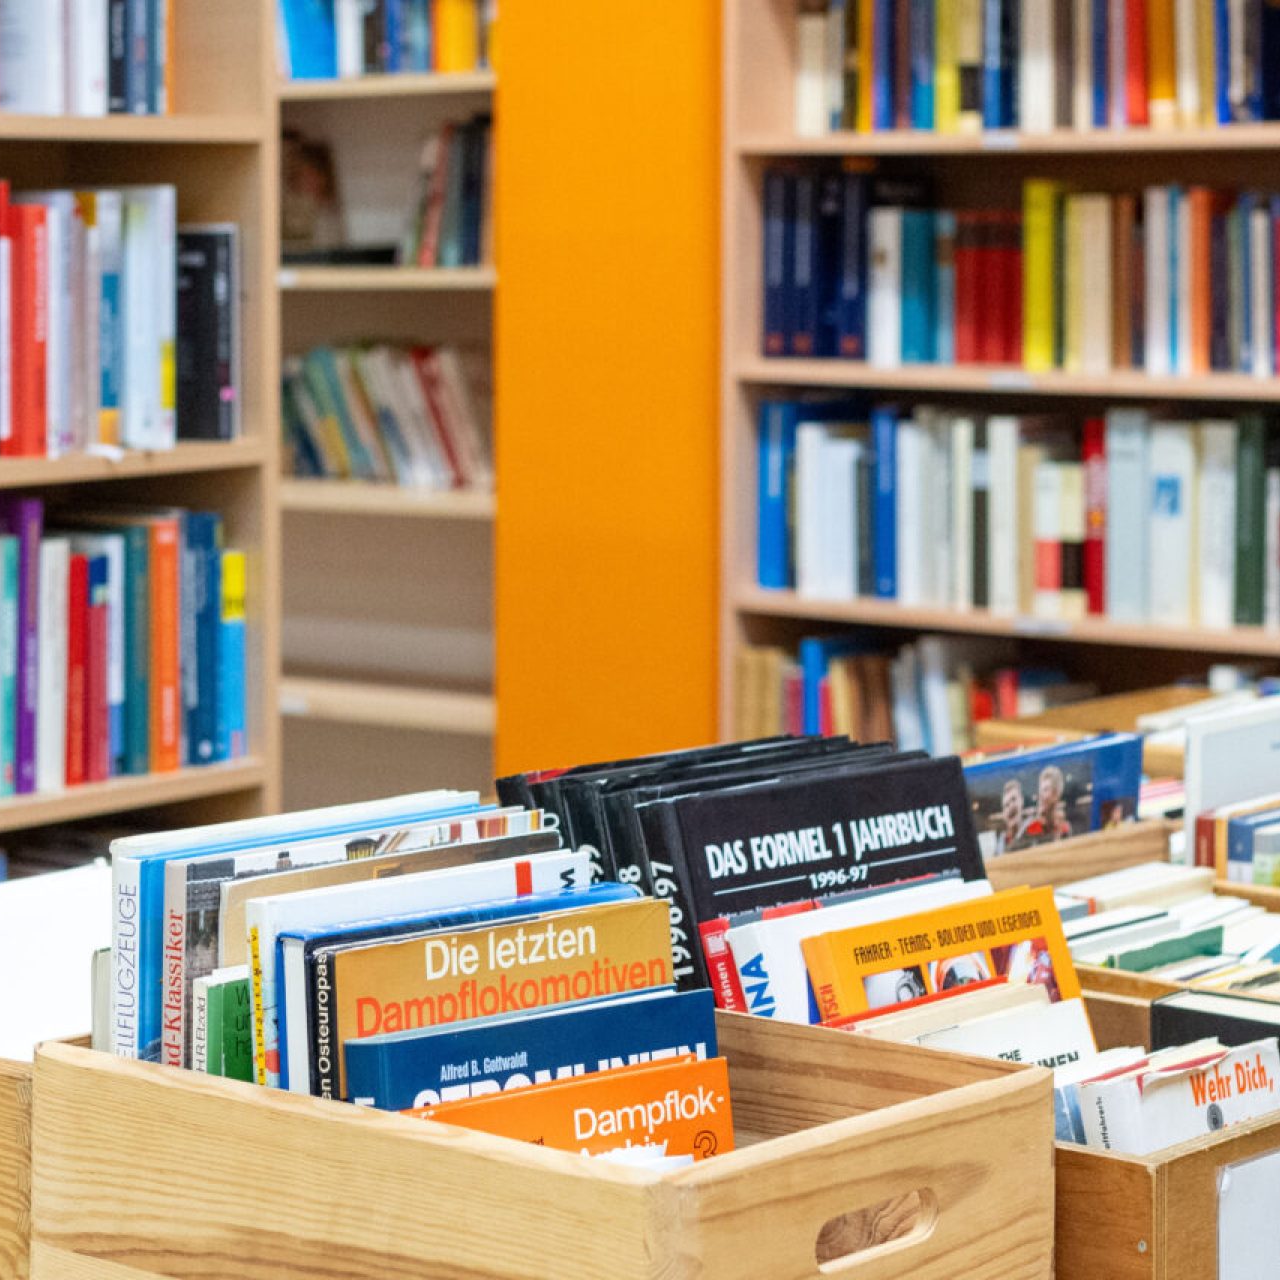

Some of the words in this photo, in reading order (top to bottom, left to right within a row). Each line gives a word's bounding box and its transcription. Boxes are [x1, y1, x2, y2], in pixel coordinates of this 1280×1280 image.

[704, 839, 749, 879] DAS
[750, 826, 833, 872] FORMEL
[832, 822, 848, 857] 1
[849, 804, 955, 862] JAHRBUCH
[809, 864, 870, 890] 1996-97
[424, 938, 479, 981] Die
[488, 923, 597, 971] letzten
[853, 941, 893, 966] FAHRER
[897, 932, 932, 956] TEAMS
[996, 909, 1043, 935] LEGENDEN
[316, 951, 332, 1074] Osteuropas
[356, 956, 667, 1038] Dampflokomotiven
[440, 1061, 470, 1082] Alfred
[471, 1060, 481, 1077] B.
[483, 1051, 529, 1074] Gottwaldt
[1190, 1063, 1232, 1107] Wehr
[1234, 1054, 1274, 1094] Dich,
[574, 1086, 725, 1142] Dampflok-
